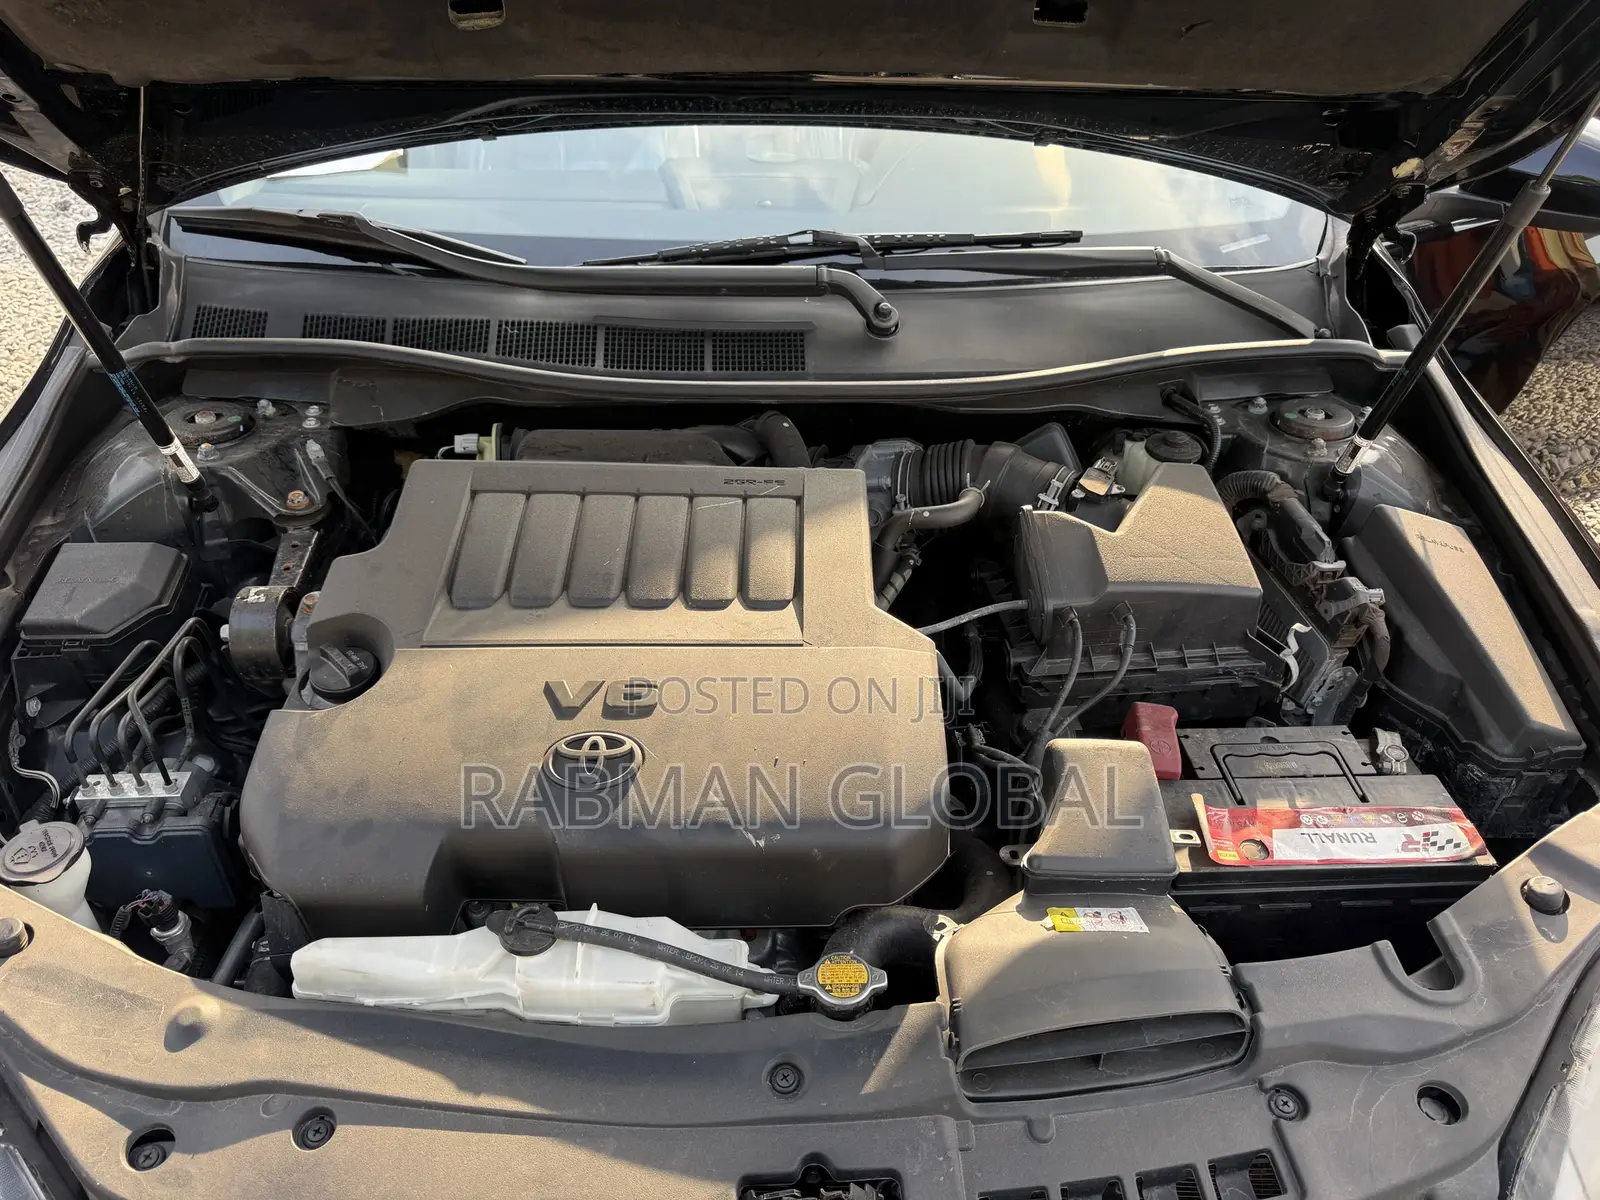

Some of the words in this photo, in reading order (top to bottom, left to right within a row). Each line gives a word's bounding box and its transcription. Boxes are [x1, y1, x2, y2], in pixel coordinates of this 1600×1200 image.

[543, 679, 659, 721] V6
[1300, 830, 1378, 846] RUNALL
[763, 975, 784, 985] WATER
